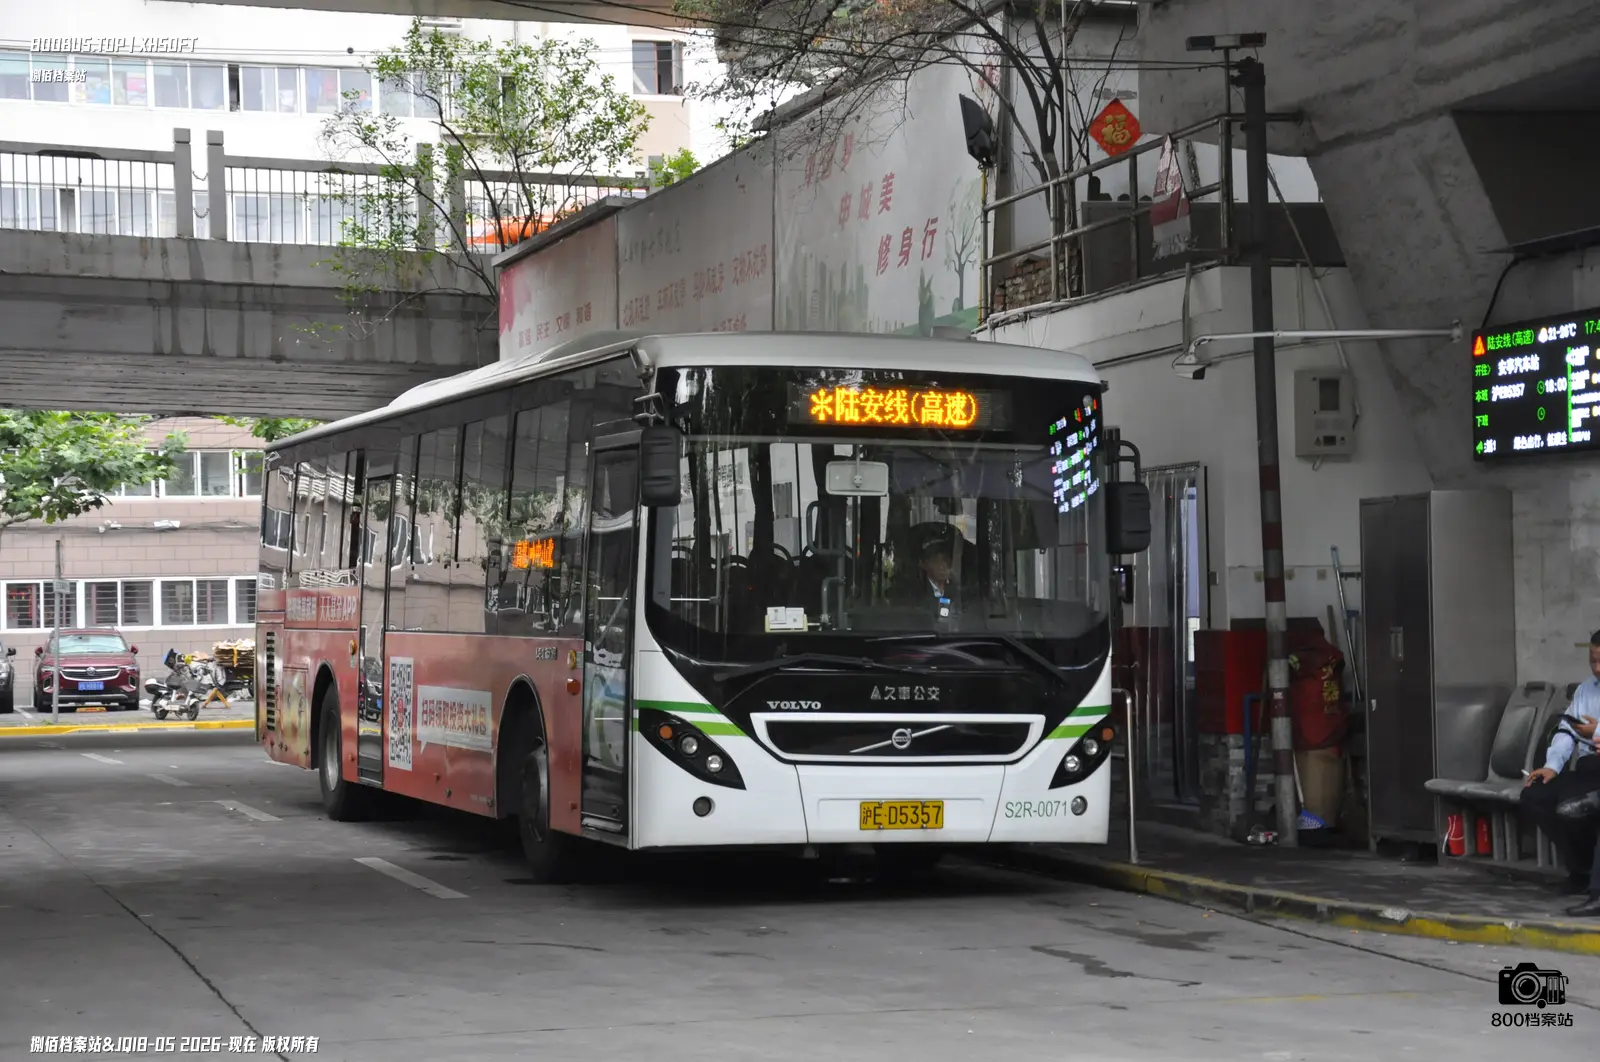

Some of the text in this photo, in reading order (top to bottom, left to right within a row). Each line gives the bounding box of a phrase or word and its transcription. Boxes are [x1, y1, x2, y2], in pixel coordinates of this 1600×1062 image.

[1101, 113, 1131, 146] 福
[838, 172, 895, 231] 申城美
[876, 216, 938, 277] 修身行
[1486, 329, 1535, 351] 陆安线(高速)
[835, 387, 977, 427] 陆安线(高速)
[767, 700, 821, 710] VOLVO
[1005, 800, 1068, 819] S2R-0071
